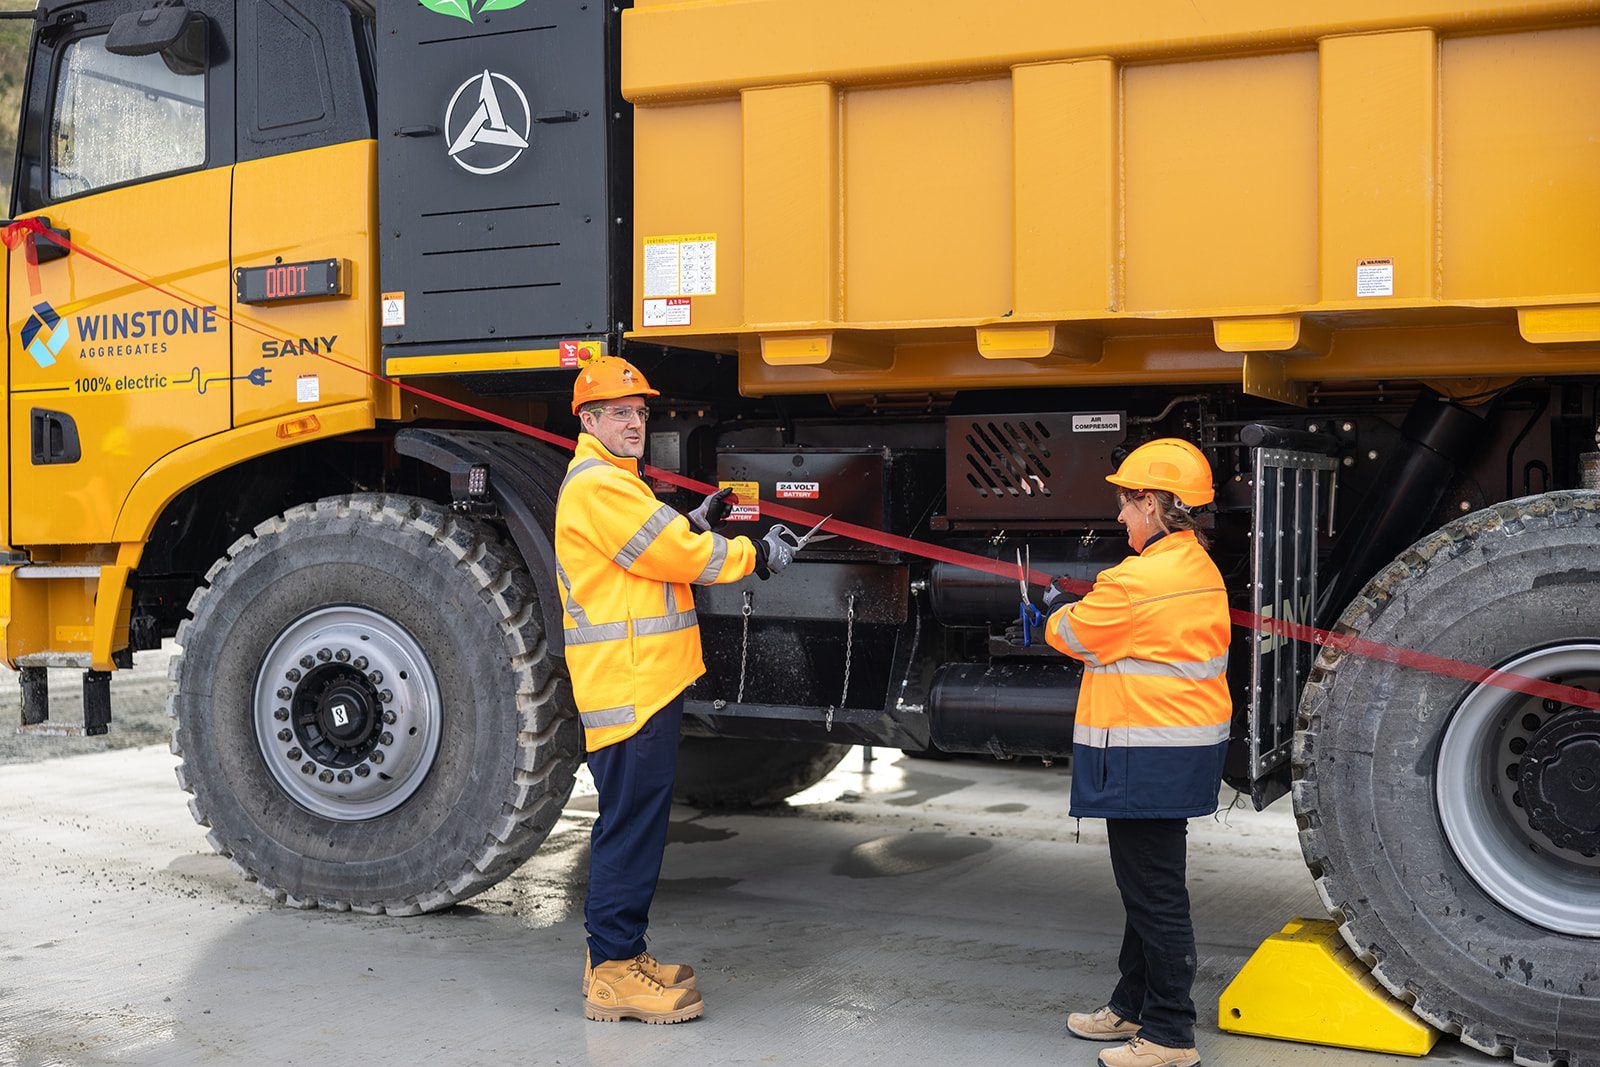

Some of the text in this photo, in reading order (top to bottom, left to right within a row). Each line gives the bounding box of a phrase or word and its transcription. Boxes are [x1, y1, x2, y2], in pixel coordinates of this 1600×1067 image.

[76, 305, 217, 342] WINSTONE
[79, 342, 168, 359] AGGREGATES
[261, 335, 338, 358] SANY
[74, 373, 167, 393] 100% electric
